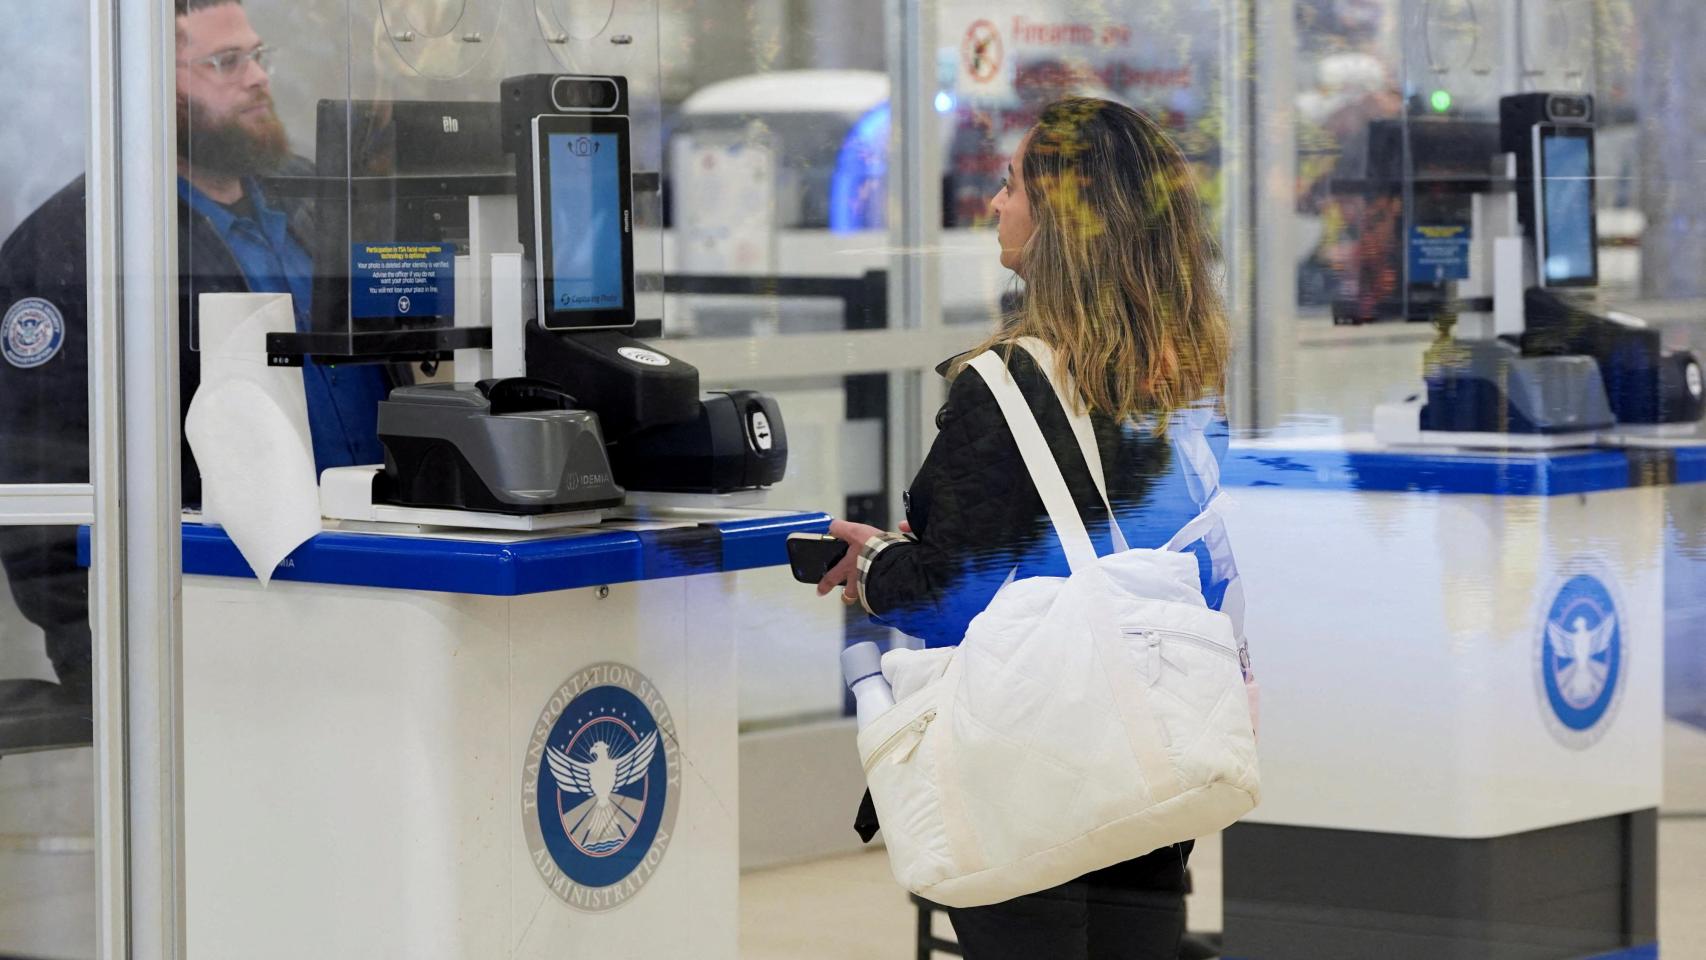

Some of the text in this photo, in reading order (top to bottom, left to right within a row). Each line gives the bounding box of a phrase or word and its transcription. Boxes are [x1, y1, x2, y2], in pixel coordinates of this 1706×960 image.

[580, 473, 609, 485] IDEMIA
[523, 665, 680, 815] TRANSPORTATION SECURITY
[533, 831, 669, 907] ADMINISTRATION
